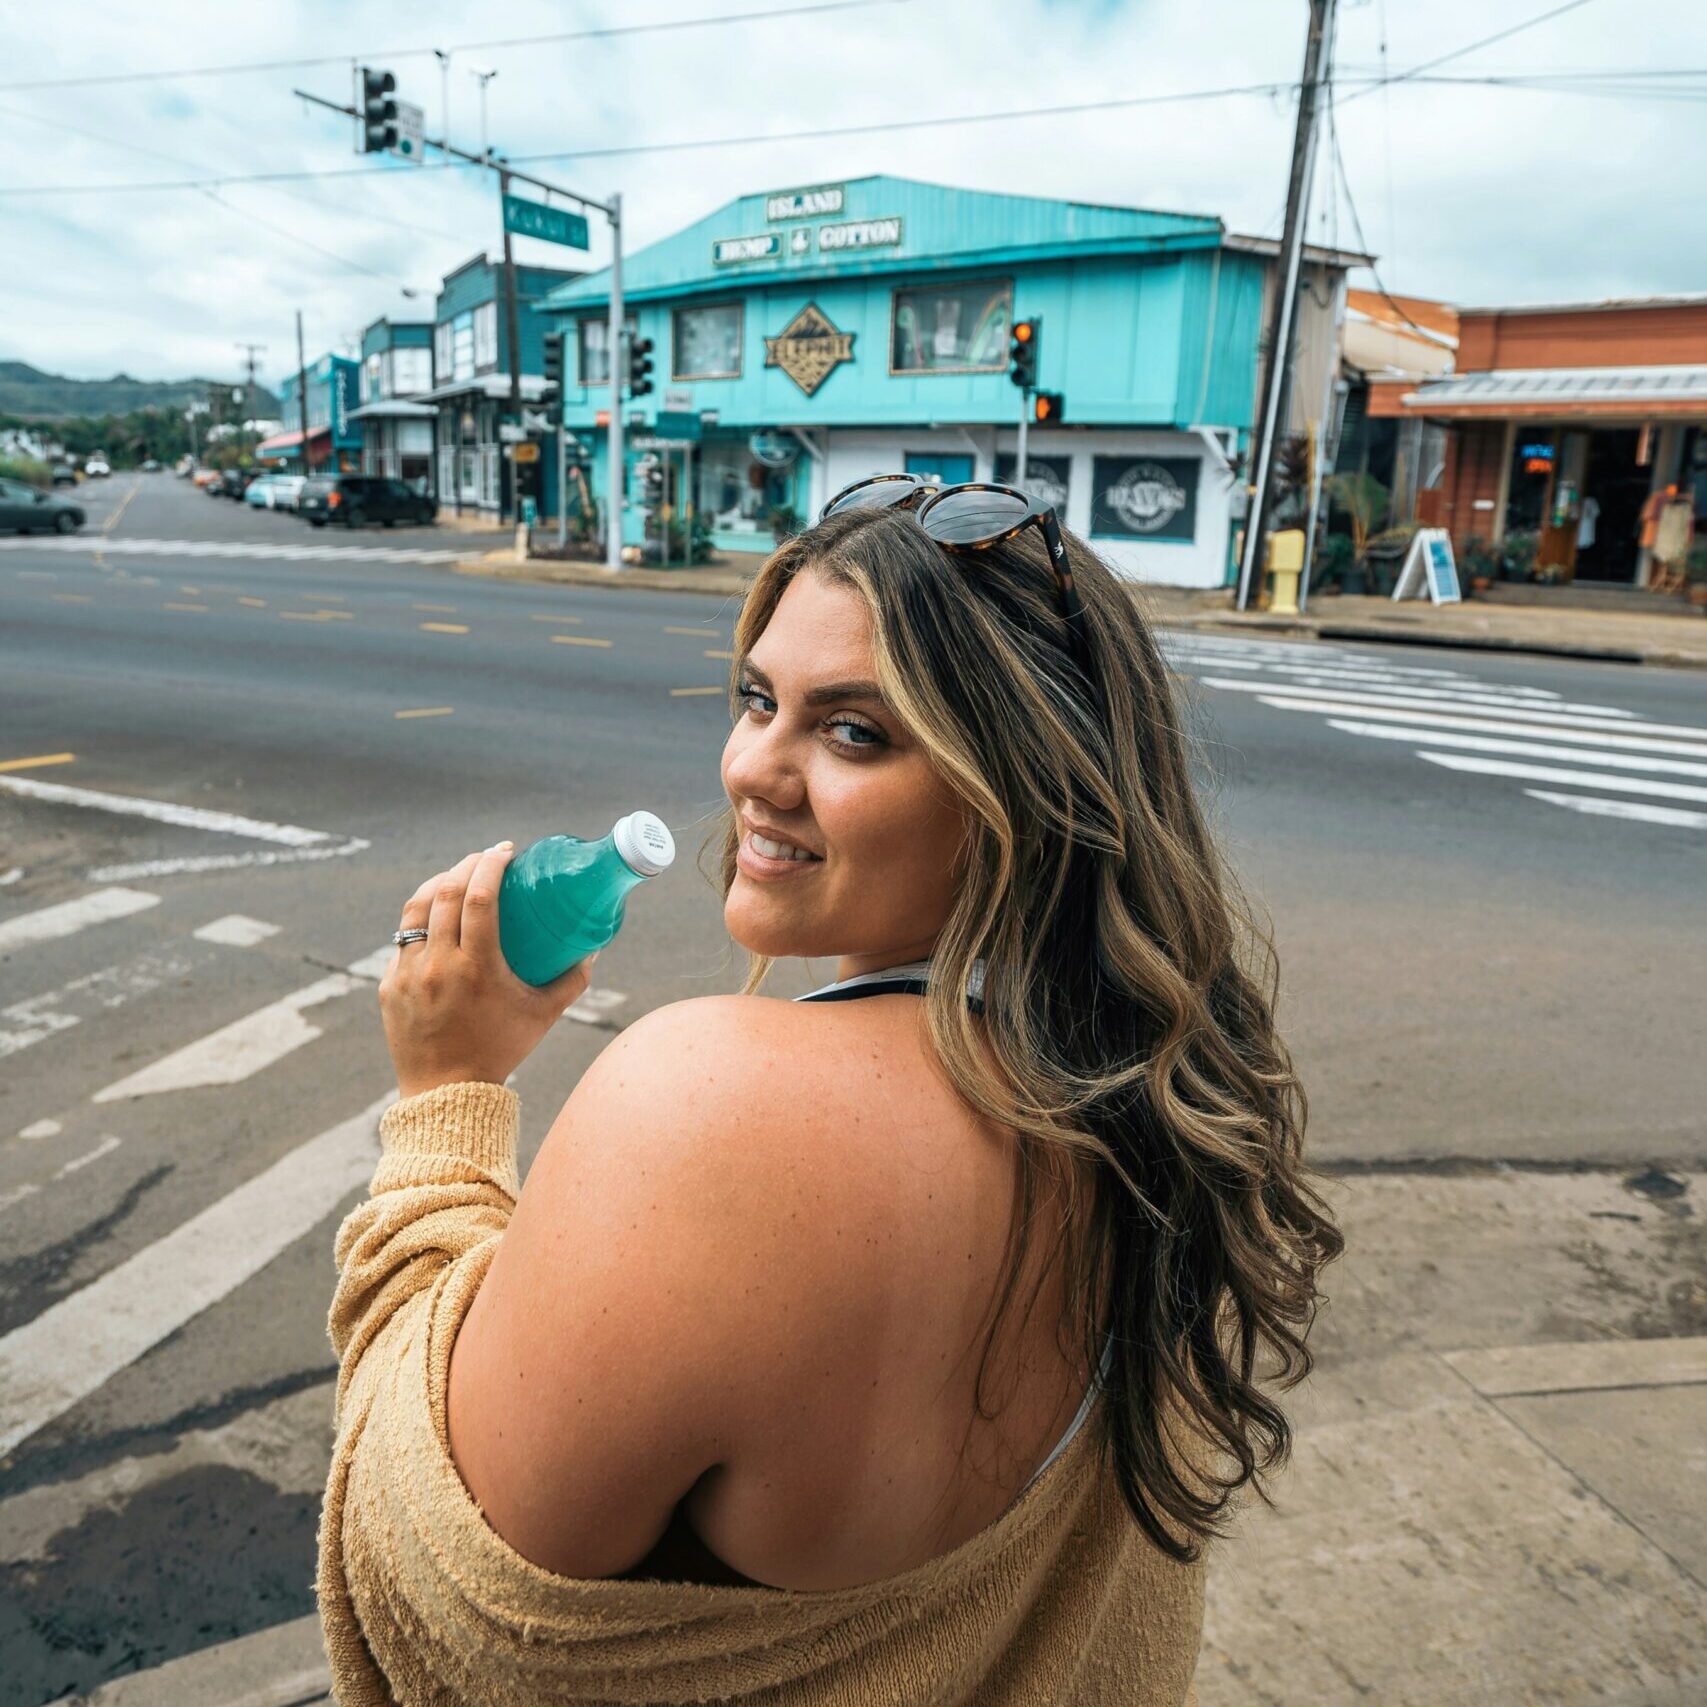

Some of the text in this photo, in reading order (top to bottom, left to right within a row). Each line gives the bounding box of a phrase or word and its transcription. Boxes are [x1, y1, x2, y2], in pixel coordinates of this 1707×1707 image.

[768, 190, 843, 220] ISLAND
[792, 231, 809, 250] &
[819, 220, 900, 248] COTTON
